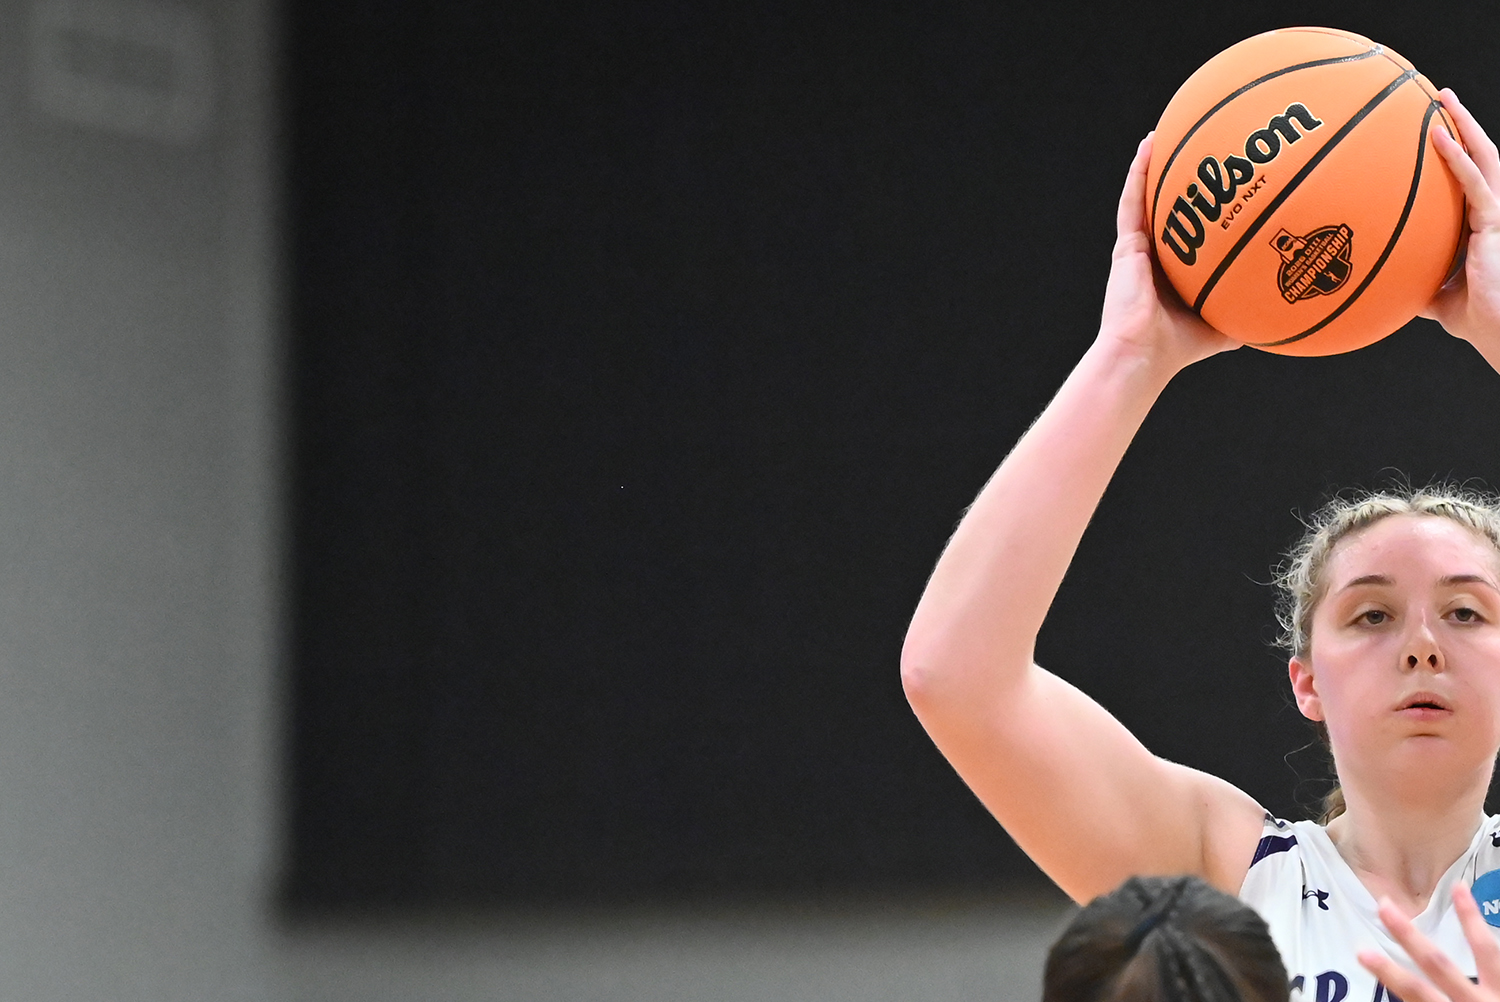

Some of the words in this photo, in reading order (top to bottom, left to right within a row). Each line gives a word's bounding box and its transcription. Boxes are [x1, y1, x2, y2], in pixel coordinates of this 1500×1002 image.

[1161, 102, 1325, 267] Wilson
[1221, 203, 1243, 230] EVO
[1242, 174, 1267, 202] NXT
[1284, 226, 1350, 303] CHAMPIONSHIP
[1305, 233, 1335, 266] BASKETBALL
